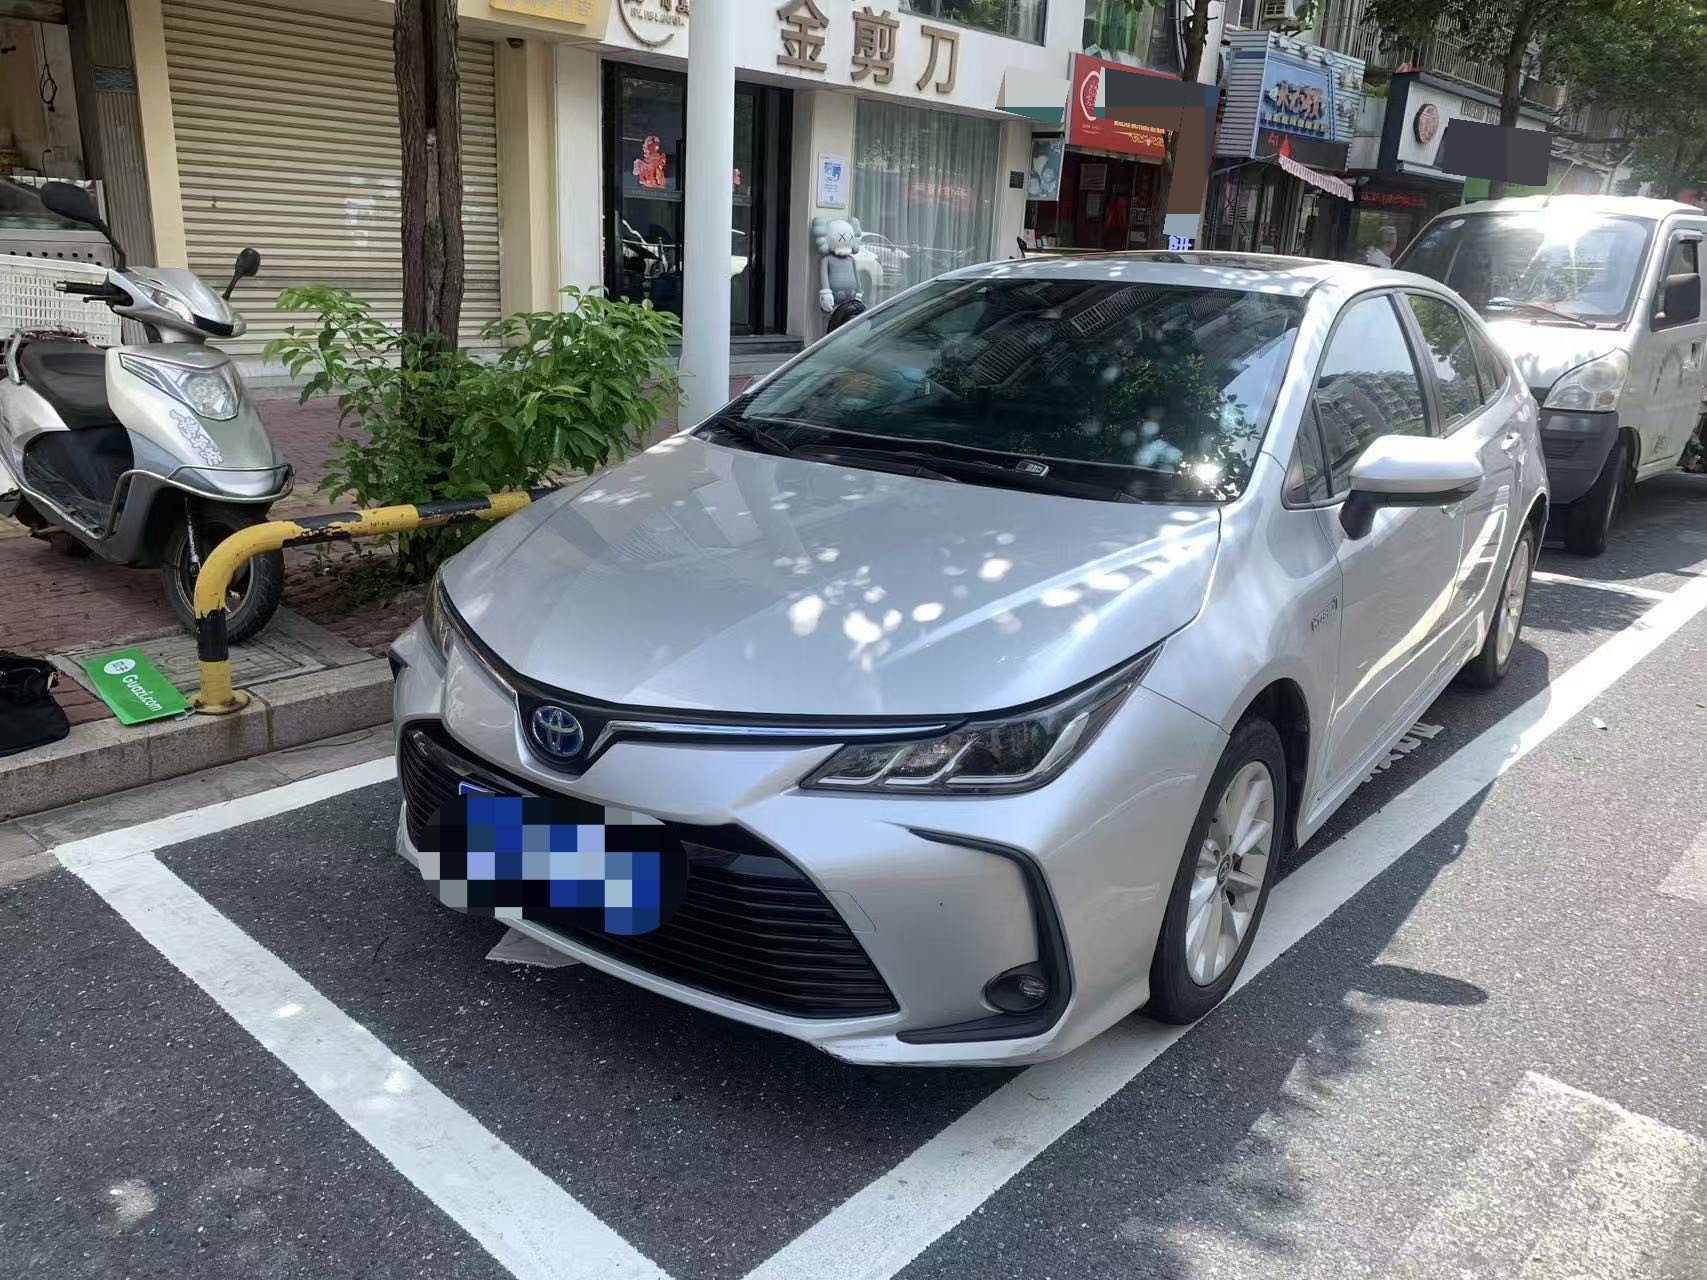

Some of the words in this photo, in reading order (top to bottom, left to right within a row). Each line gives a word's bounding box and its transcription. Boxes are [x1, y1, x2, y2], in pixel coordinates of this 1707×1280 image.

[777, 0, 960, 94] 金剪刀
[122, 675, 163, 711] Guazi.com
